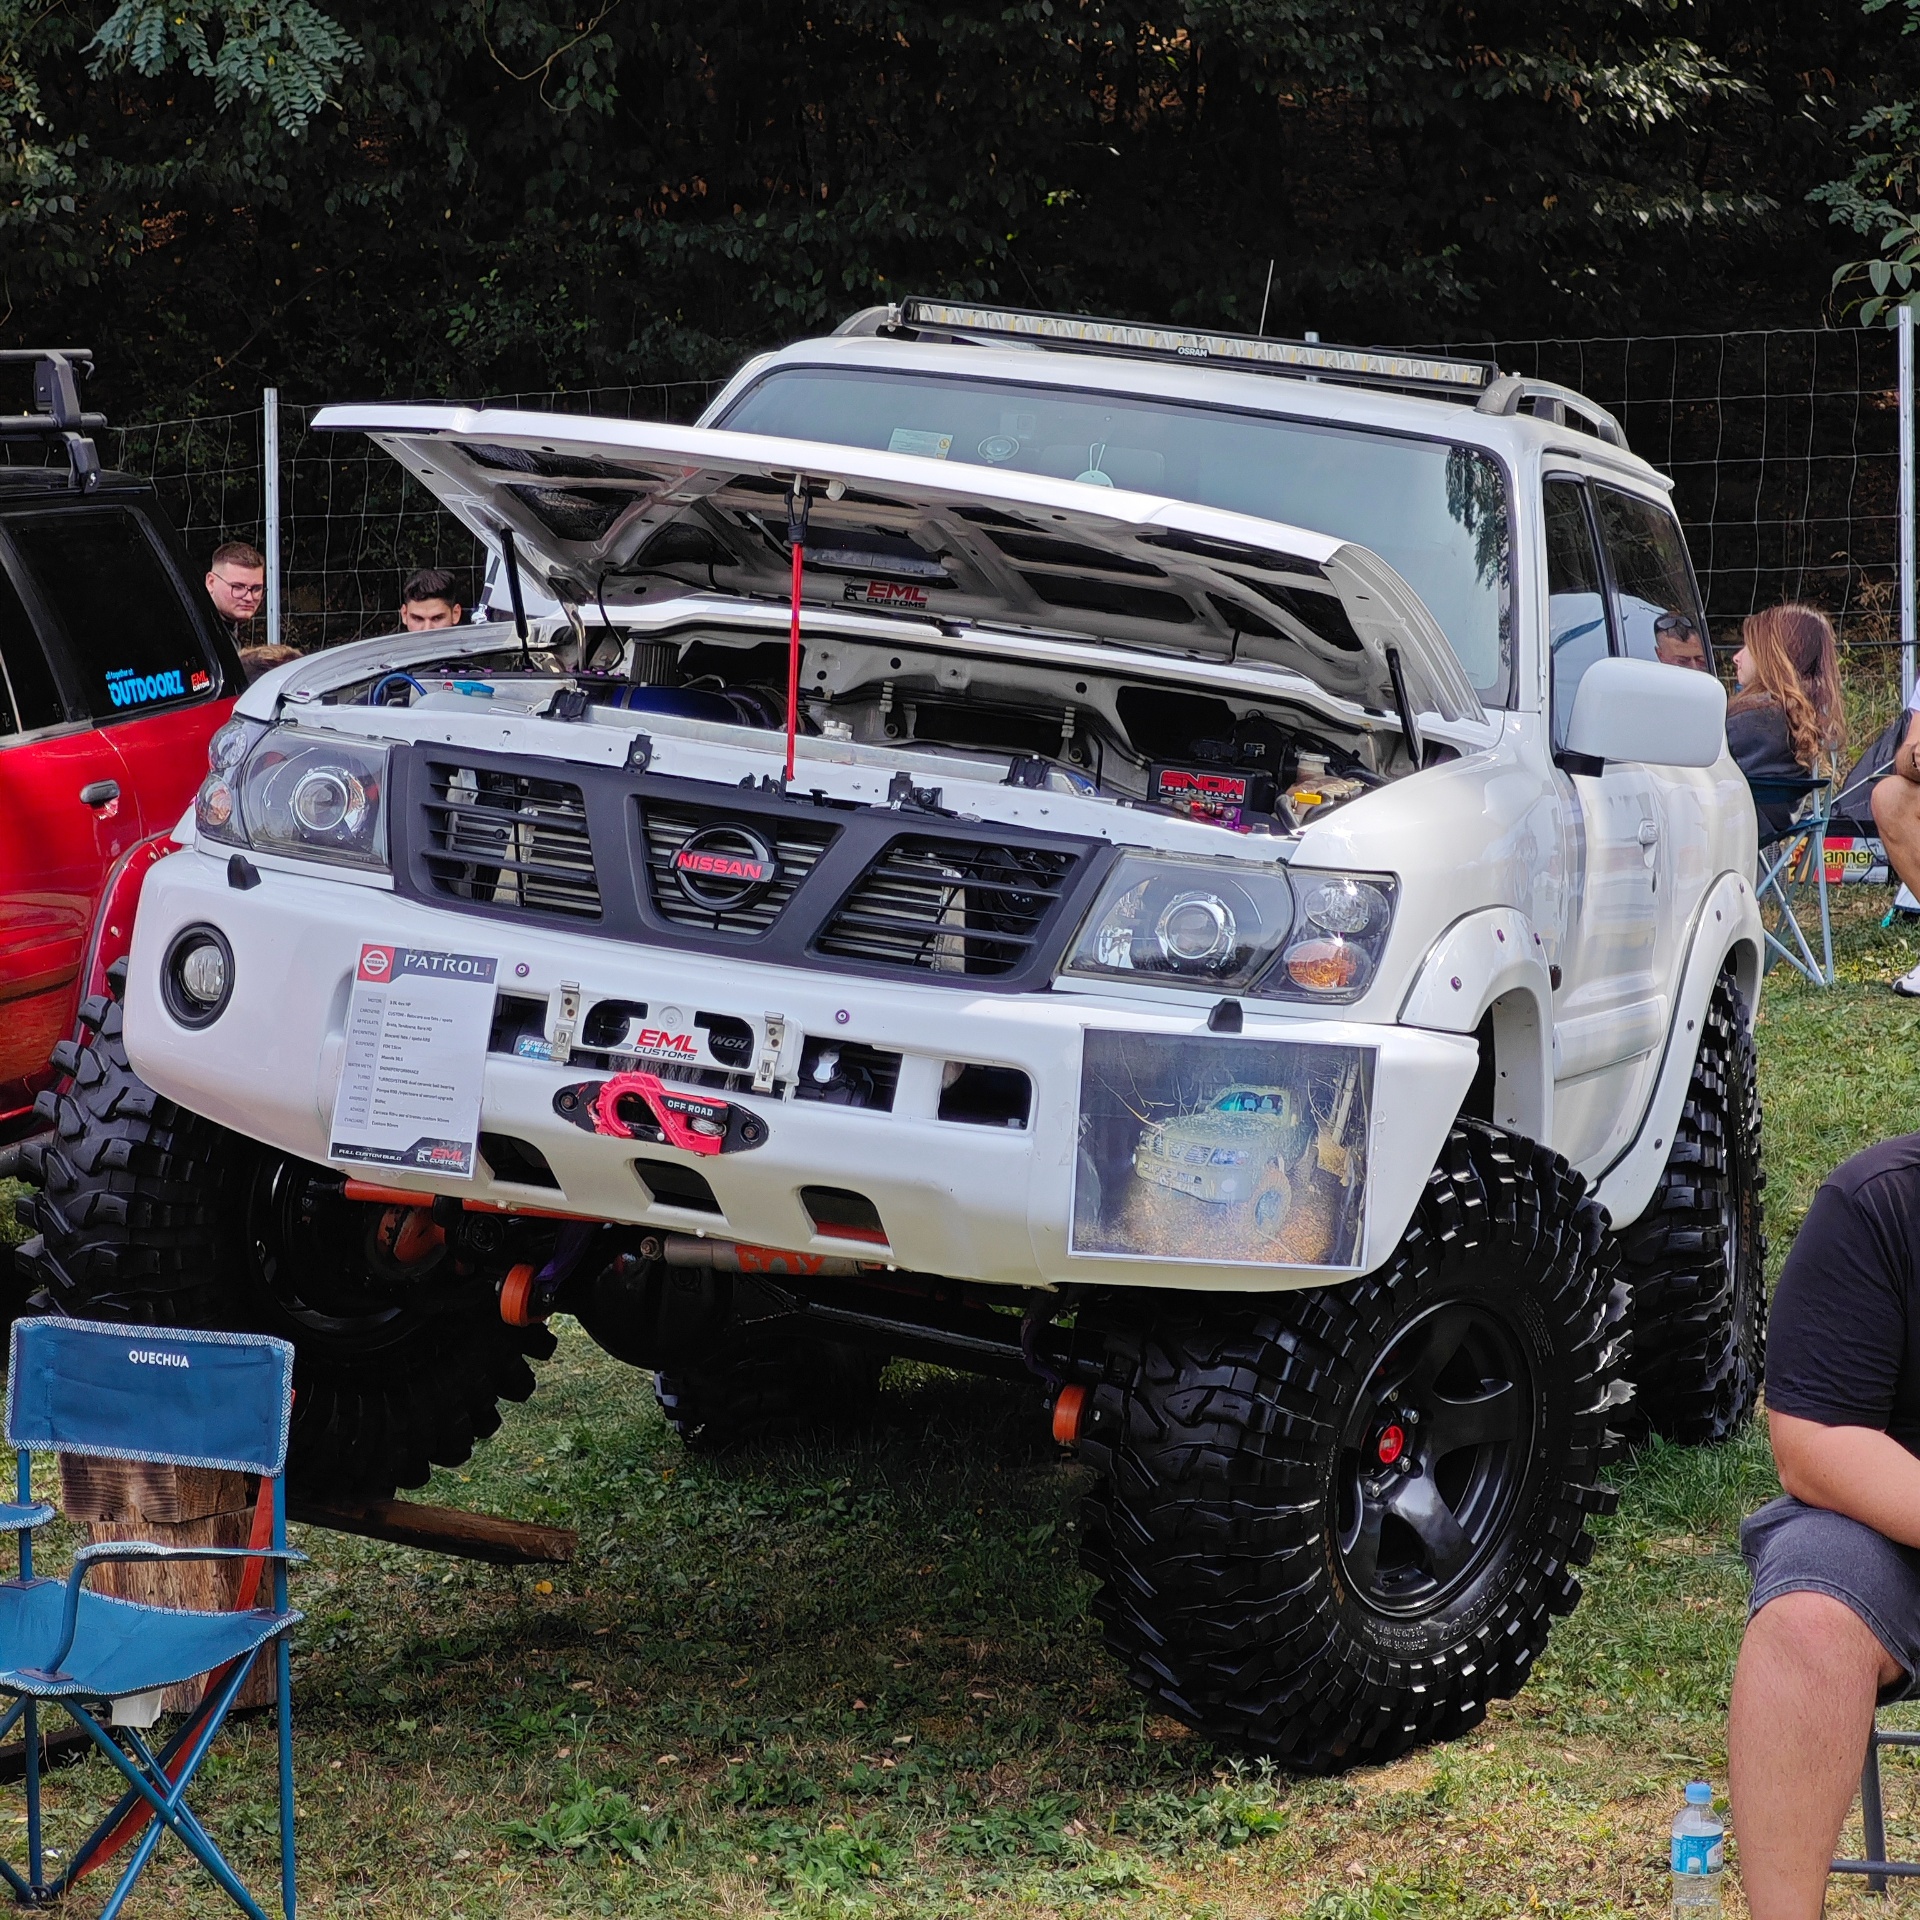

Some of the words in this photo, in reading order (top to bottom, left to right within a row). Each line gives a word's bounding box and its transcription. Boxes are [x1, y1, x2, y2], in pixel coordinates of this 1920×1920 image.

[1177, 346, 1207, 357] OSRAM
[867, 581, 928, 602] EML
[867, 597, 926, 609] CUSTOMS
[191, 670, 208, 687] EML
[1160, 771, 1245, 794] SNOW
[677, 852, 762, 879] NISSAN
[1823, 848, 1873, 865] anner
[404, 953, 485, 977] PATROL
[636, 1028, 698, 1054] EML
[633, 1045, 697, 1061] CUSTOMS
[667, 1099, 686, 1110] OFF
[687, 1104, 714, 1117] ROAD
[355, 1151, 382, 1159] CUSTOM
[382, 1153, 402, 1161] BUILD
[128, 1350, 190, 1369] QUECHUA
